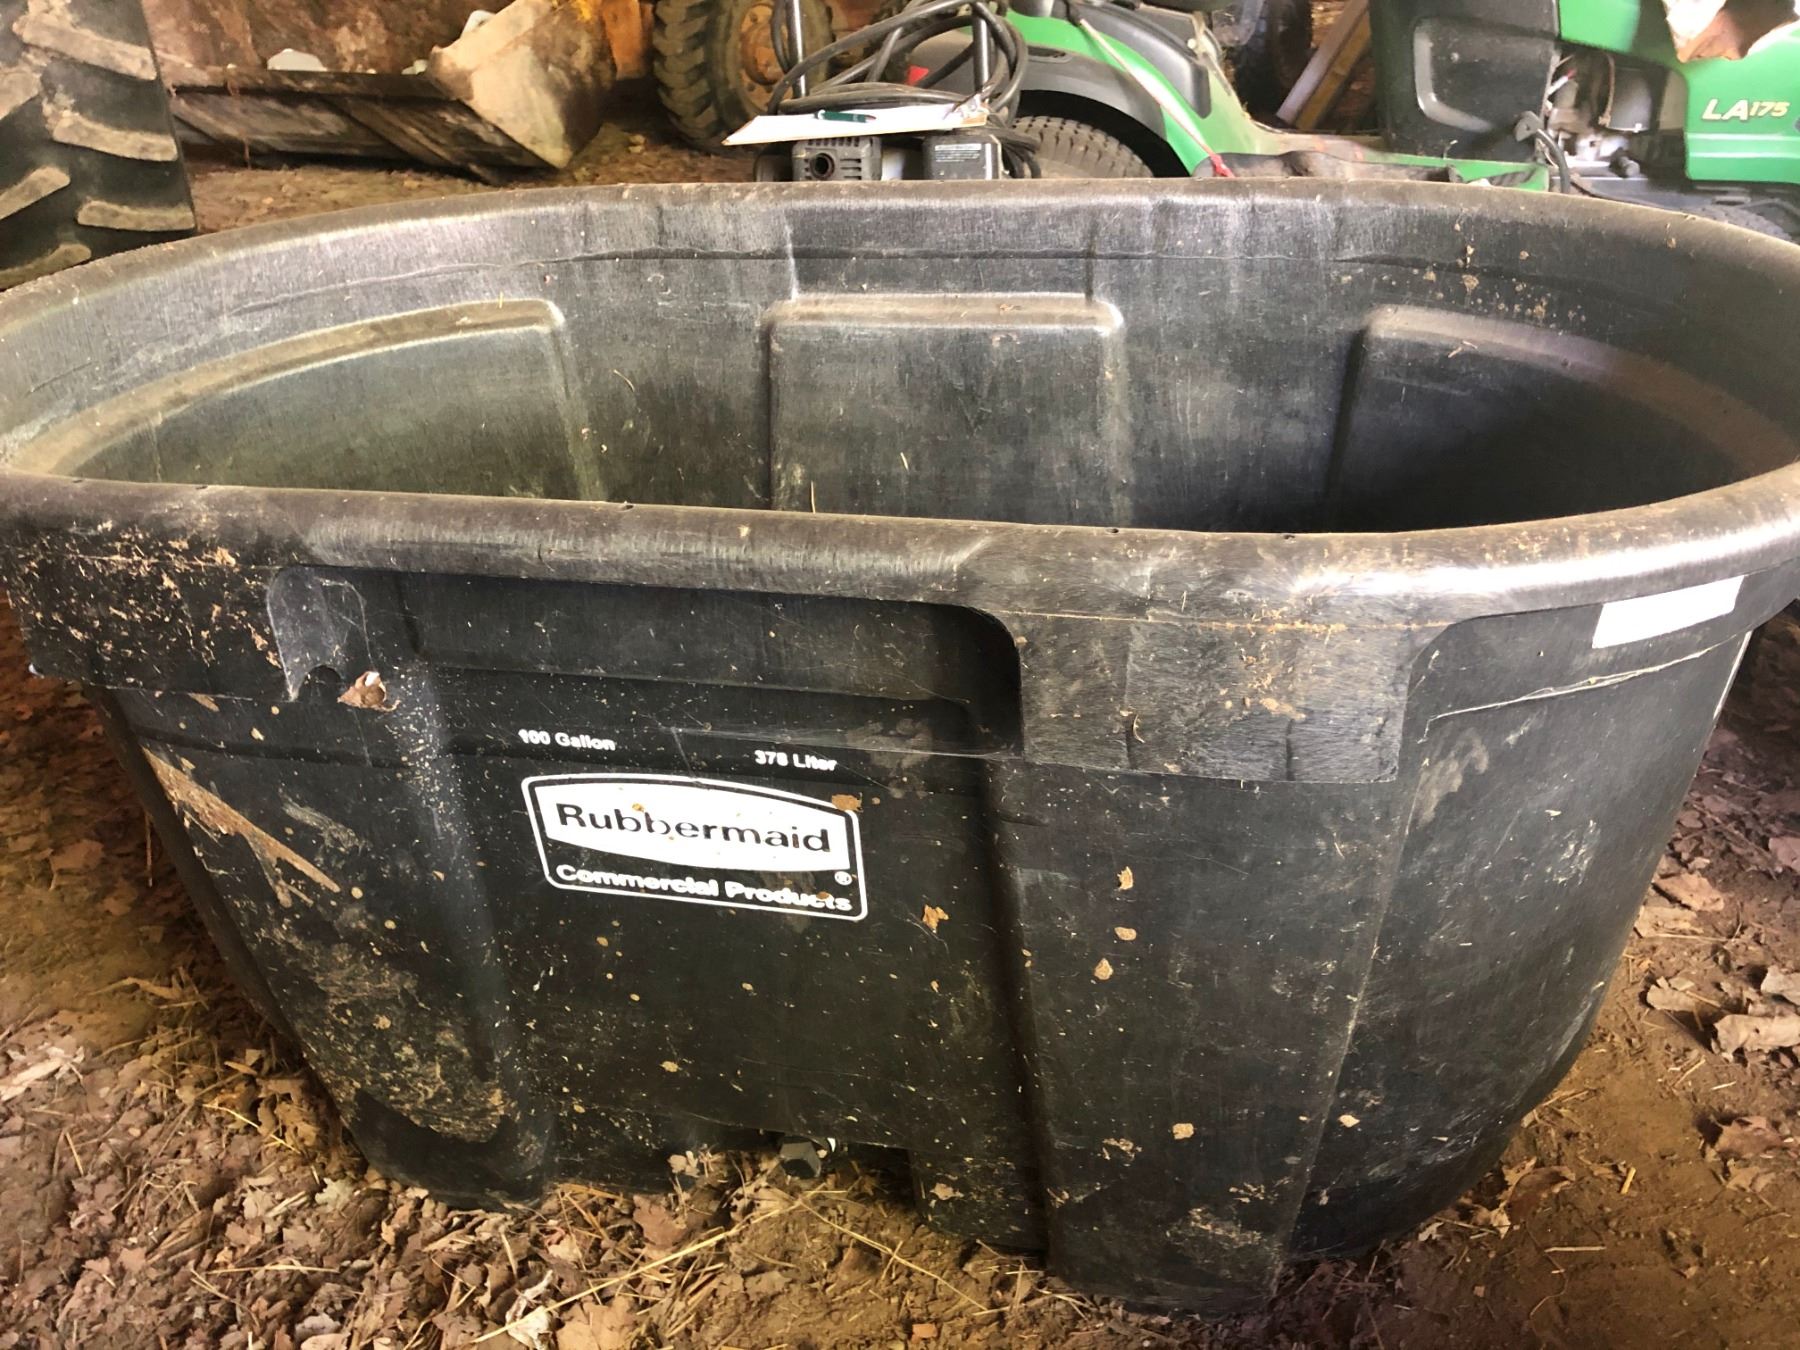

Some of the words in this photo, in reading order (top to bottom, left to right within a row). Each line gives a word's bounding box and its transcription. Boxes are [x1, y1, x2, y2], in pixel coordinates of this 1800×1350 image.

[1702, 98, 1790, 121] LA175
[518, 728, 551, 745] 100
[554, 732, 616, 751] Gallon
[754, 749, 788, 767] 378
[792, 753, 838, 771] Liter
[555, 802, 831, 853] Rubbermaid
[556, 864, 719, 897] Commercial
[724, 880, 853, 912] Products
